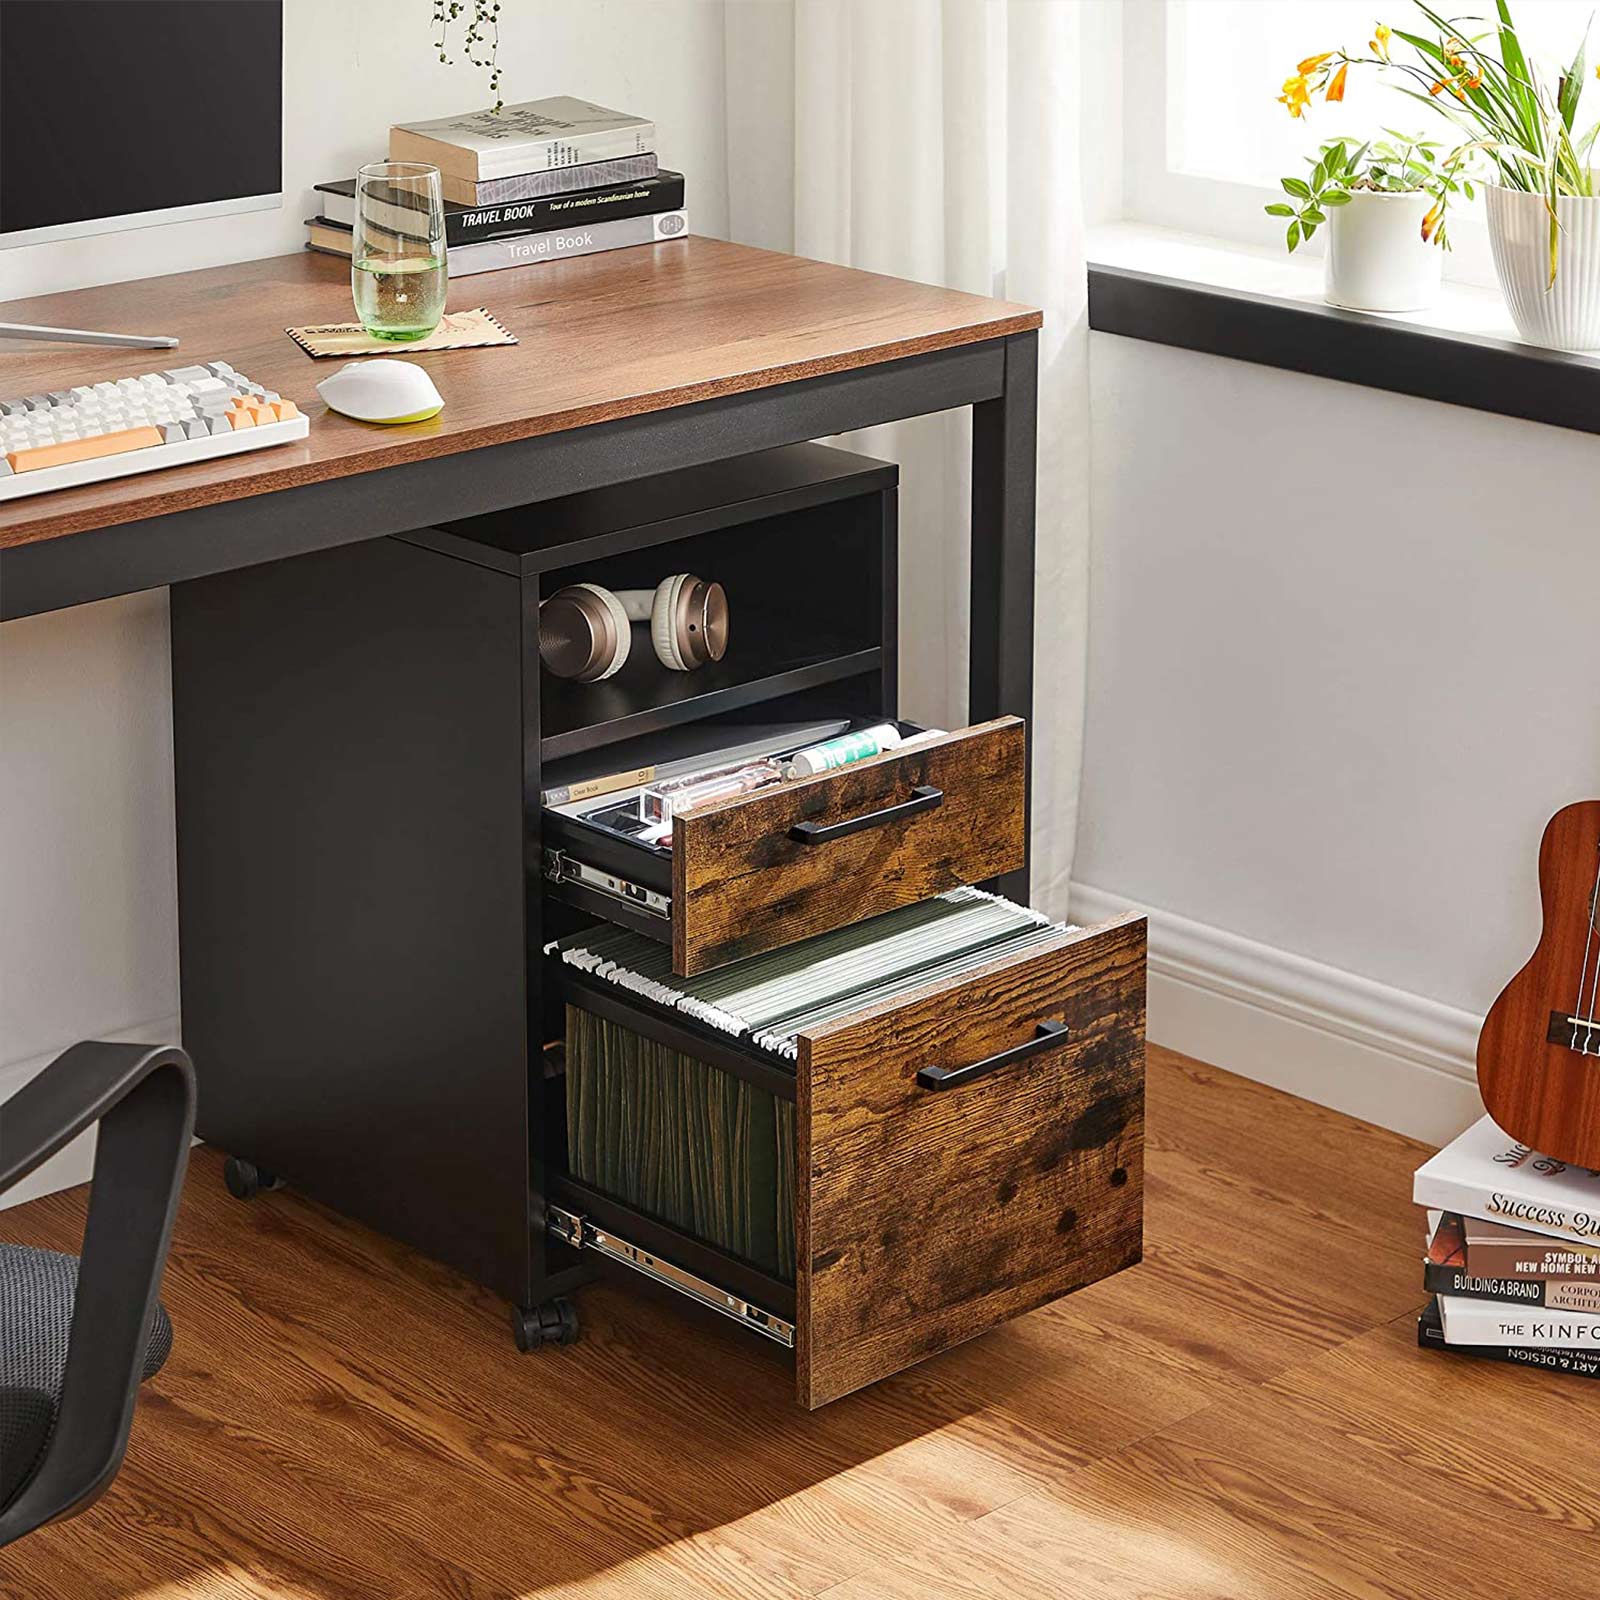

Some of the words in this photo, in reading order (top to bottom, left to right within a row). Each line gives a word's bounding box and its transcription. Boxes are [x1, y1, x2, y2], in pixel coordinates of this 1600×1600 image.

[549, 203, 562, 211] Tour
[562, 200, 571, 209] of
[575, 198, 597, 207] modern
[597, 192, 634, 205] Scandinavian
[634, 190, 650, 198] home
[462, 208, 501, 228] TRAVEL
[503, 204, 536, 222] BOOK
[507, 242, 551, 259] Travel
[556, 232, 593, 251] Book
[586, 785, 599, 793] Book
[1487, 1192, 1566, 1228] Success
[1545, 1252, 1588, 1264] SYMBOL
[1515, 1262, 1539, 1273] NEW
[1540, 1262, 1571, 1274] HOME
[1574, 1263, 1596, 1275] NEW
[1454, 1275, 1499, 1294] BUILDING
[1506, 1280, 1540, 1299] BRAND
[1560, 1285, 1600, 1297] CORPO
[1499, 1324, 1525, 1336] THE
[1508, 1348, 1556, 1366] DESIGN
[1558, 1357, 1570, 1368] &
[1572, 1362, 1598, 1374] ART
